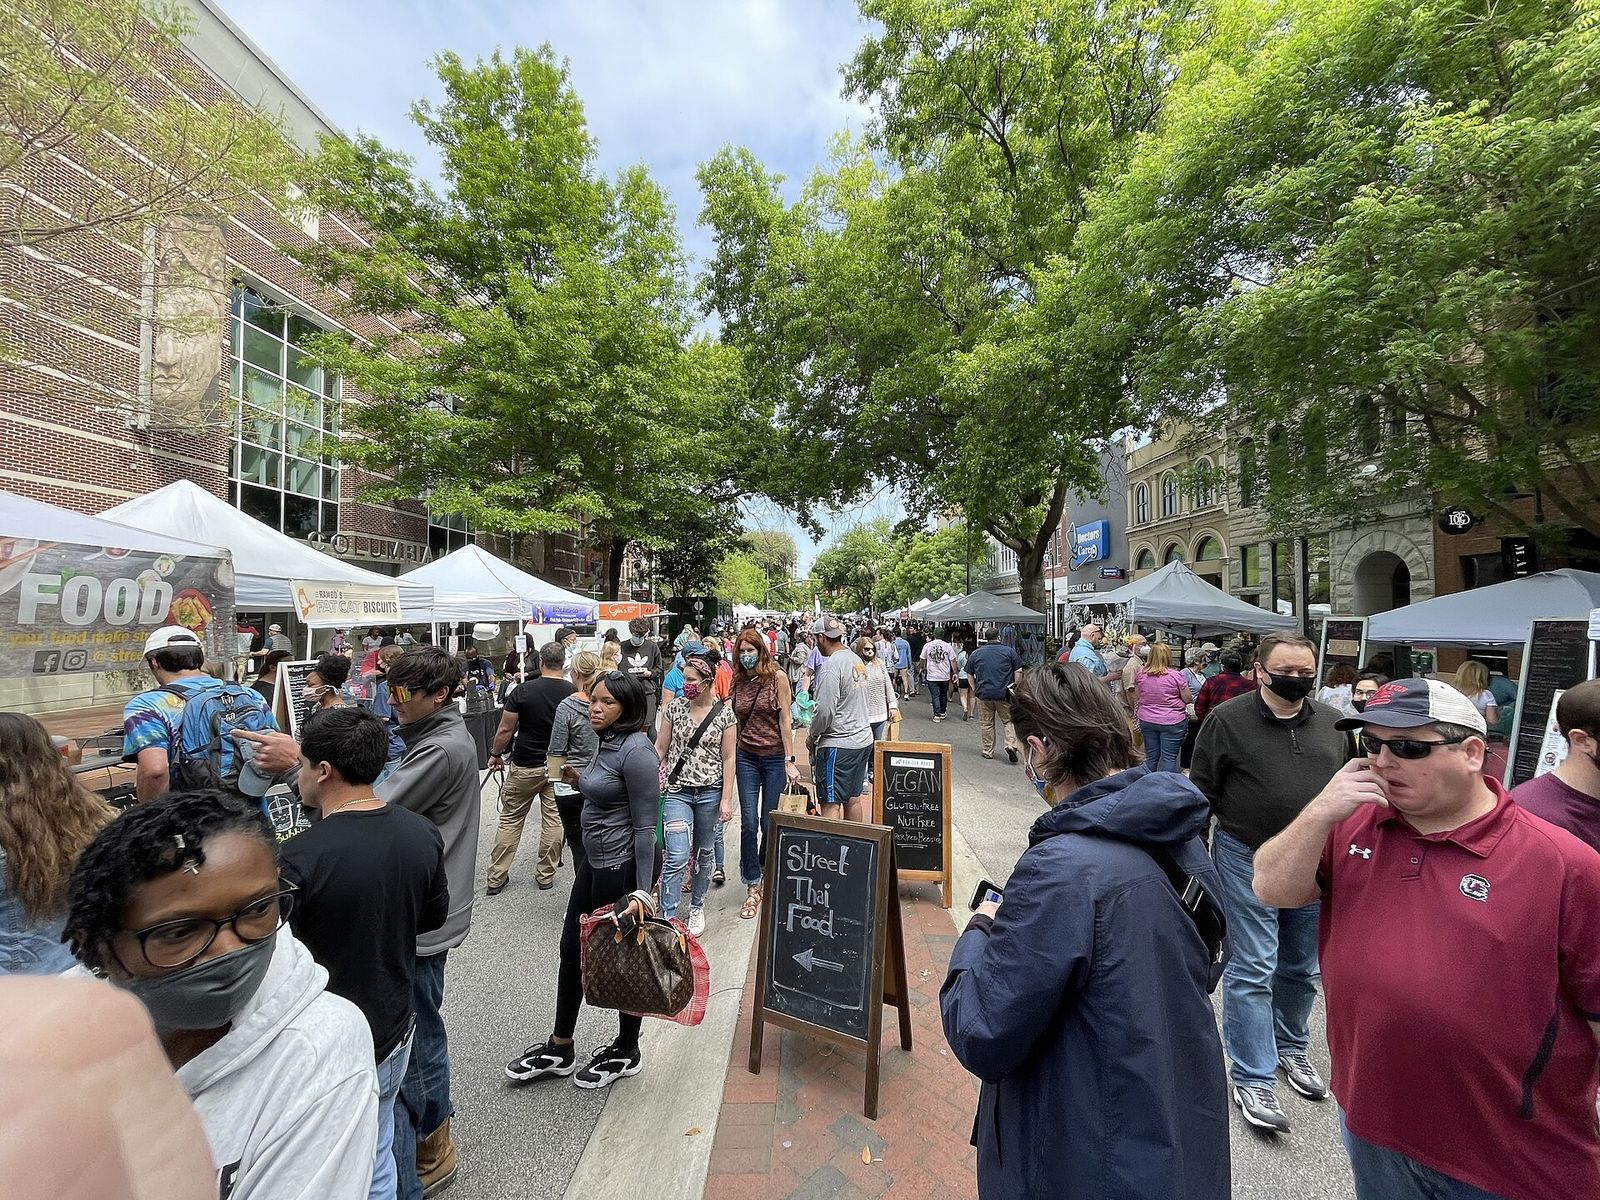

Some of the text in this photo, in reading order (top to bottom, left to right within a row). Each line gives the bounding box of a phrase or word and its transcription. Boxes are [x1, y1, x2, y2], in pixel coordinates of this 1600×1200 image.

[1077, 530, 1100, 544] Doctors
[1082, 583, 1095, 592] CARE
[17, 573, 173, 626] FOOD
[316, 600, 398, 613] FAT CAT BISCUITS
[92, 631, 129, 643] make
[110, 648, 144, 662] stree
[883, 770, 941, 792] VEGAN
[786, 840, 850, 876] Street
[786, 876, 830, 908] Thai
